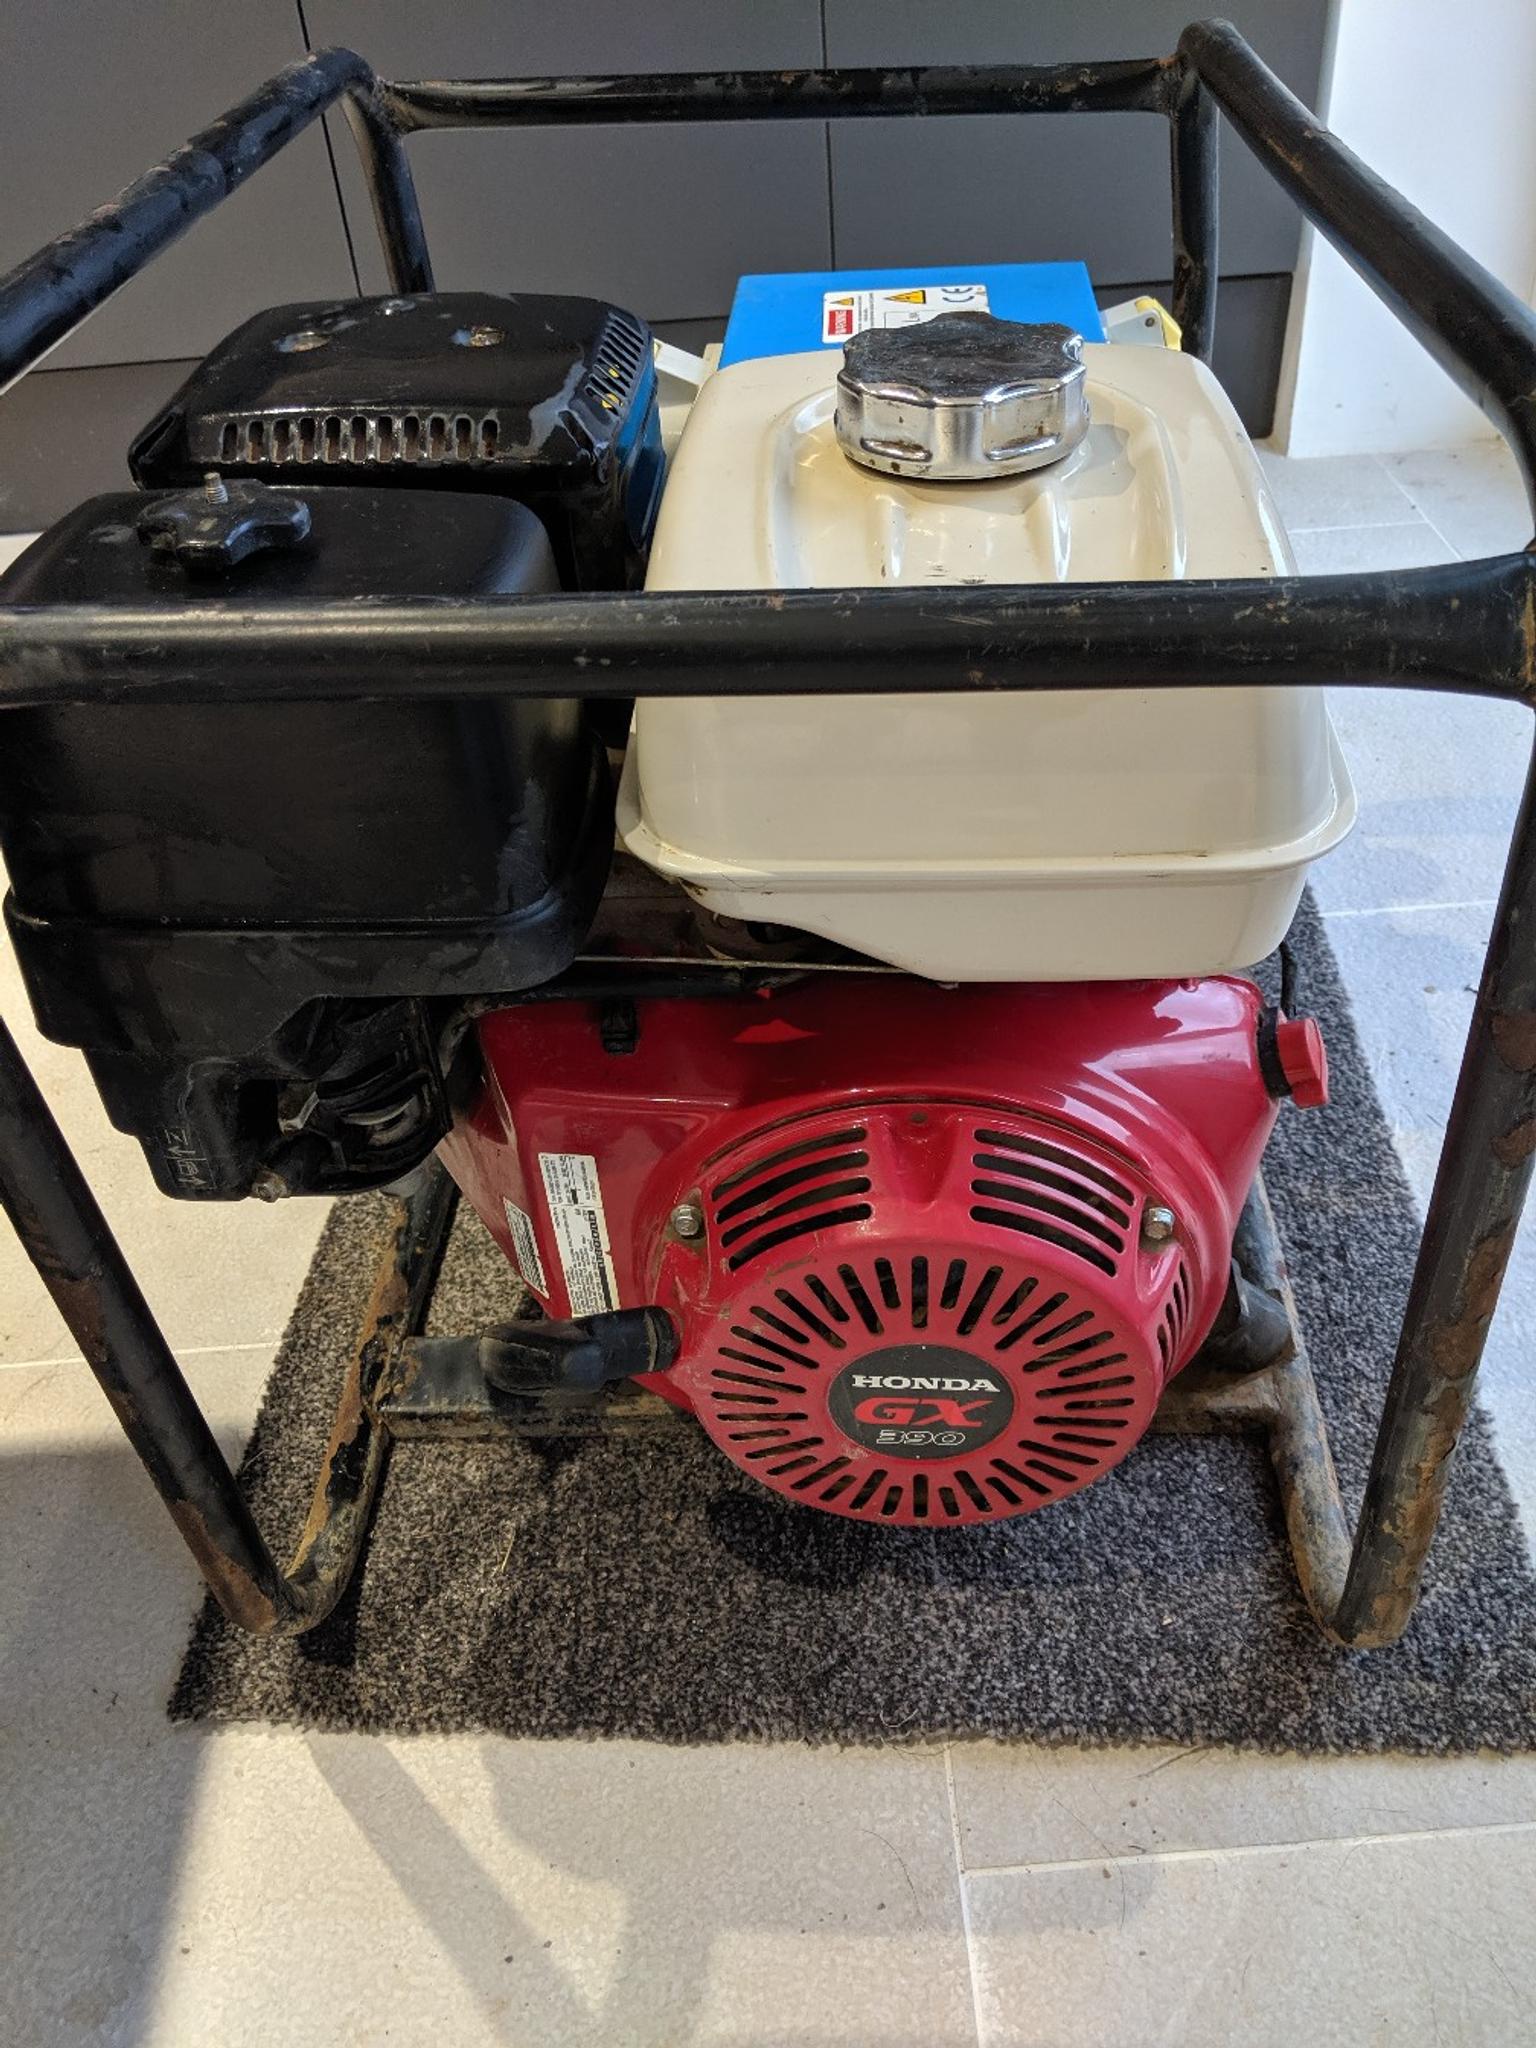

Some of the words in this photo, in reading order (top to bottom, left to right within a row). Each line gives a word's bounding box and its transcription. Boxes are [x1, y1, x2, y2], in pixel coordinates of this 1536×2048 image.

[852, 1375, 1000, 1392] HONDA
[854, 1397, 993, 1427] GX
[876, 1430, 966, 1446] 390
